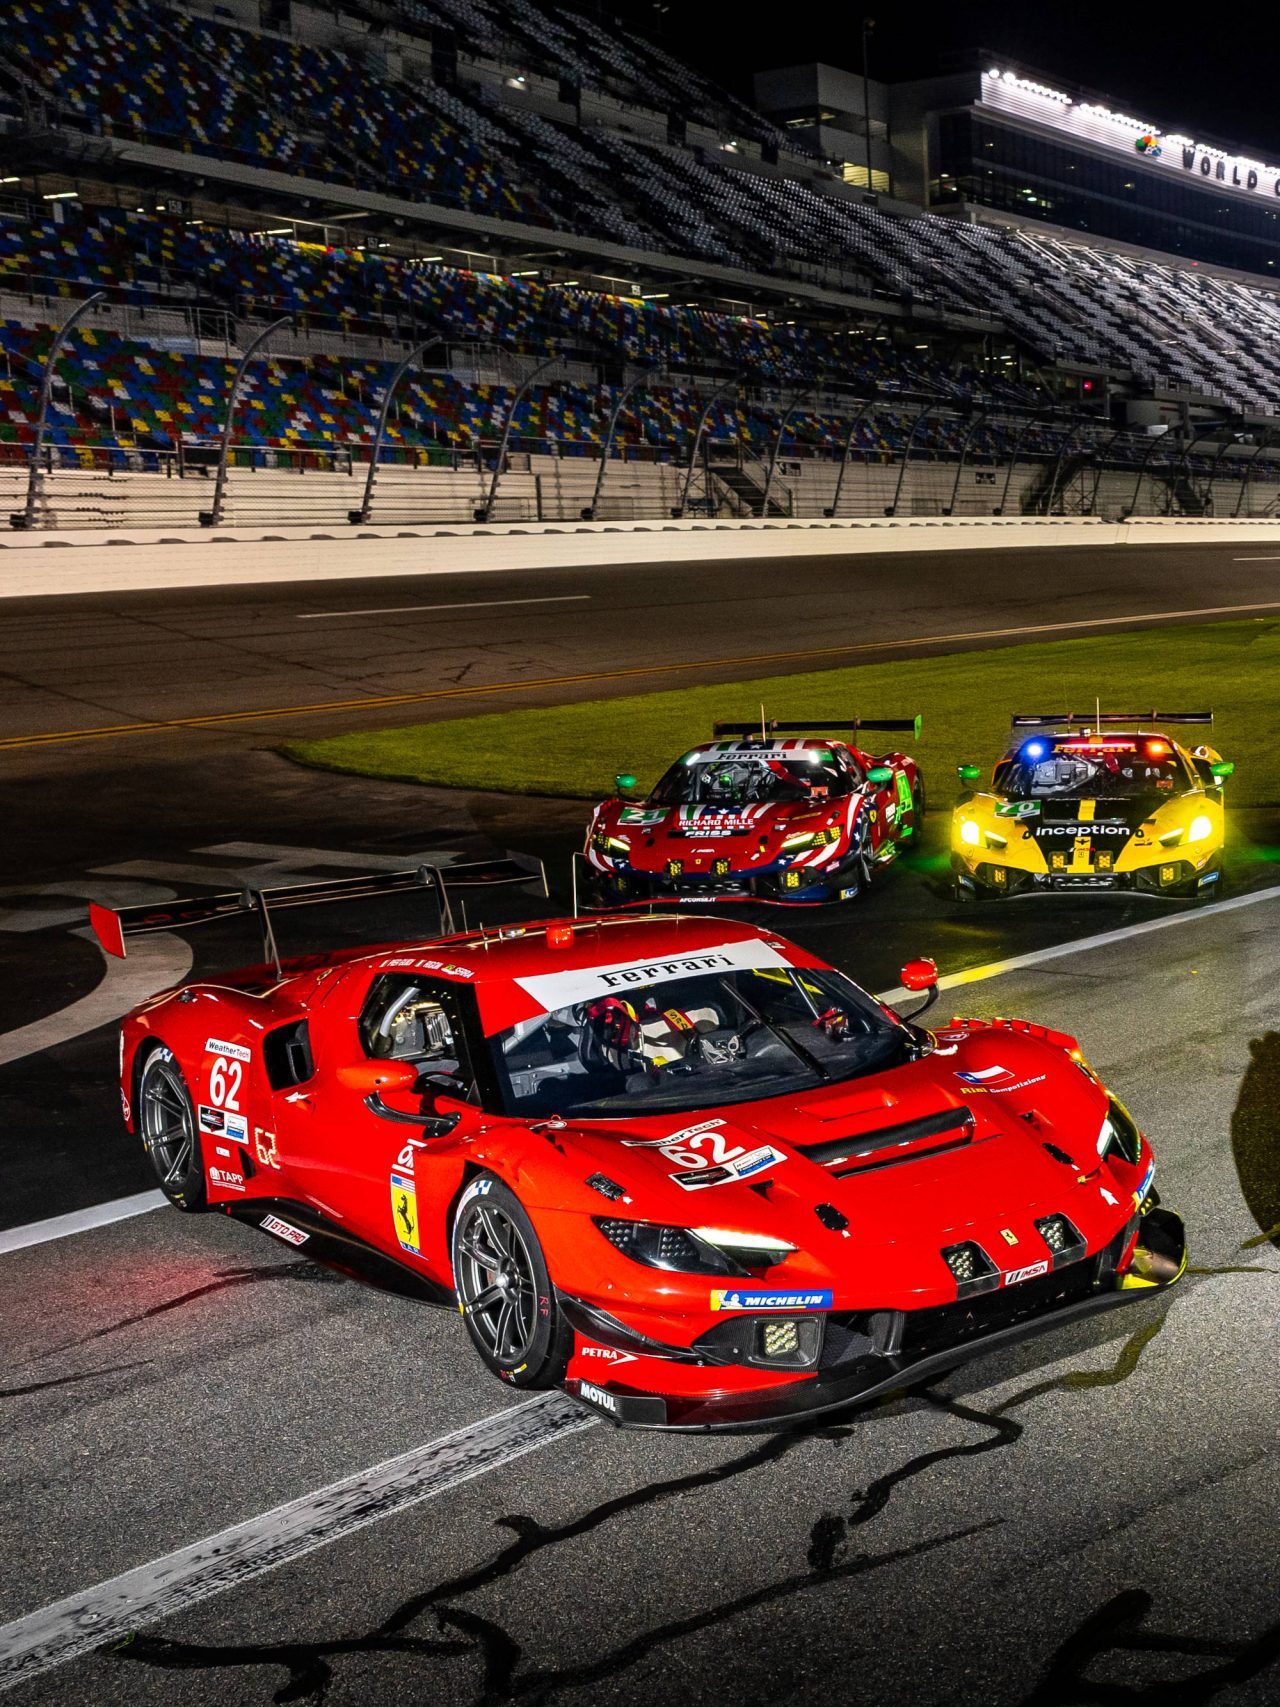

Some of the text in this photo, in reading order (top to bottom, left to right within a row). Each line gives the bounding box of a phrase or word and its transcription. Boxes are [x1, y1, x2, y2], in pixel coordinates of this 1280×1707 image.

[1181, 146, 1258, 190] WORLD
[715, 751, 787, 761] Ferrari
[724, 818, 754, 826] MILLE
[1036, 824, 1131, 837] inception
[597, 954, 735, 988] Ferrari
[208, 1041, 250, 1059] WeatherTech
[210, 1057, 242, 1112] 62
[658, 1132, 746, 1169] 62
[219, 1170, 243, 1185] TAPP
[270, 1221, 306, 1243] GTD PRO
[1020, 1265, 1046, 1280] IMSA
[744, 1295, 823, 1306] MICHELIN
[581, 1347, 618, 1360] PETRA
[580, 1382, 616, 1413] MOTUL
